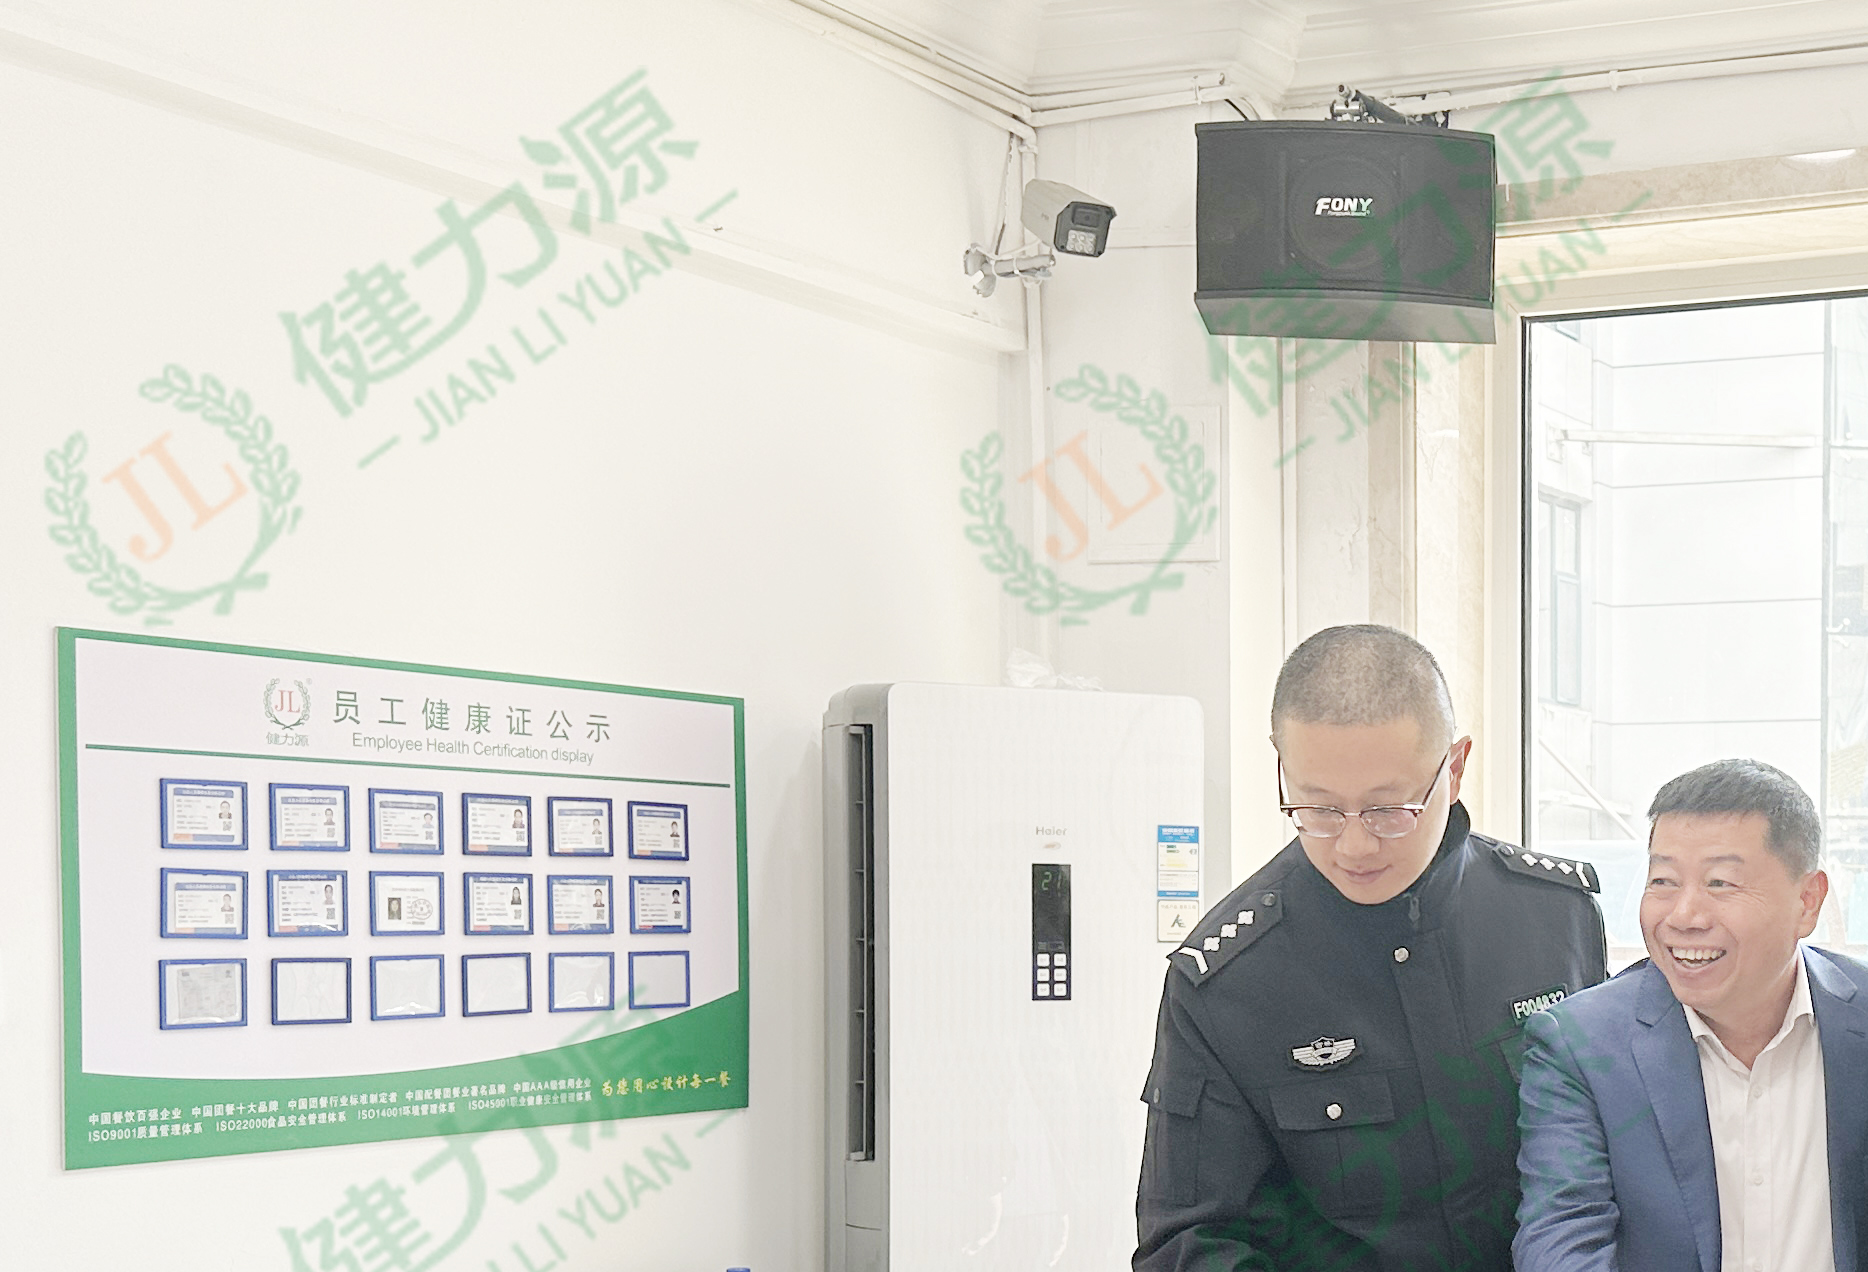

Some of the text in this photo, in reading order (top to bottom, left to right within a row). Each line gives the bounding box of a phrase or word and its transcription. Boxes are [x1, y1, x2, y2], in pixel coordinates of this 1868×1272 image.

[1314, 197, 1374, 216] FONY
[274, 689, 301, 713] JL
[332, 690, 611, 743] 员工健康证公示
[266, 731, 310, 746] 健力源
[353, 732, 595, 766] Employee Health Certification display
[1035, 826, 1068, 836] Haier
[601, 1070, 732, 1097] 为您用心设计每一餐
[88, 1108, 182, 1125] 中国餐饮百强企业
[191, 1100, 279, 1118] 中国团餐十大品牌
[288, 1092, 398, 1110] 中国团餐行业标准制定者
[513, 1077, 592, 1094] 中国AAA级信用企业
[88, 1090, 592, 1142] ISO9001质量管理体系 ISO22000食品安全管理体系 ISO14001环境管理体系 ISO45001职业健康安全管理体系
